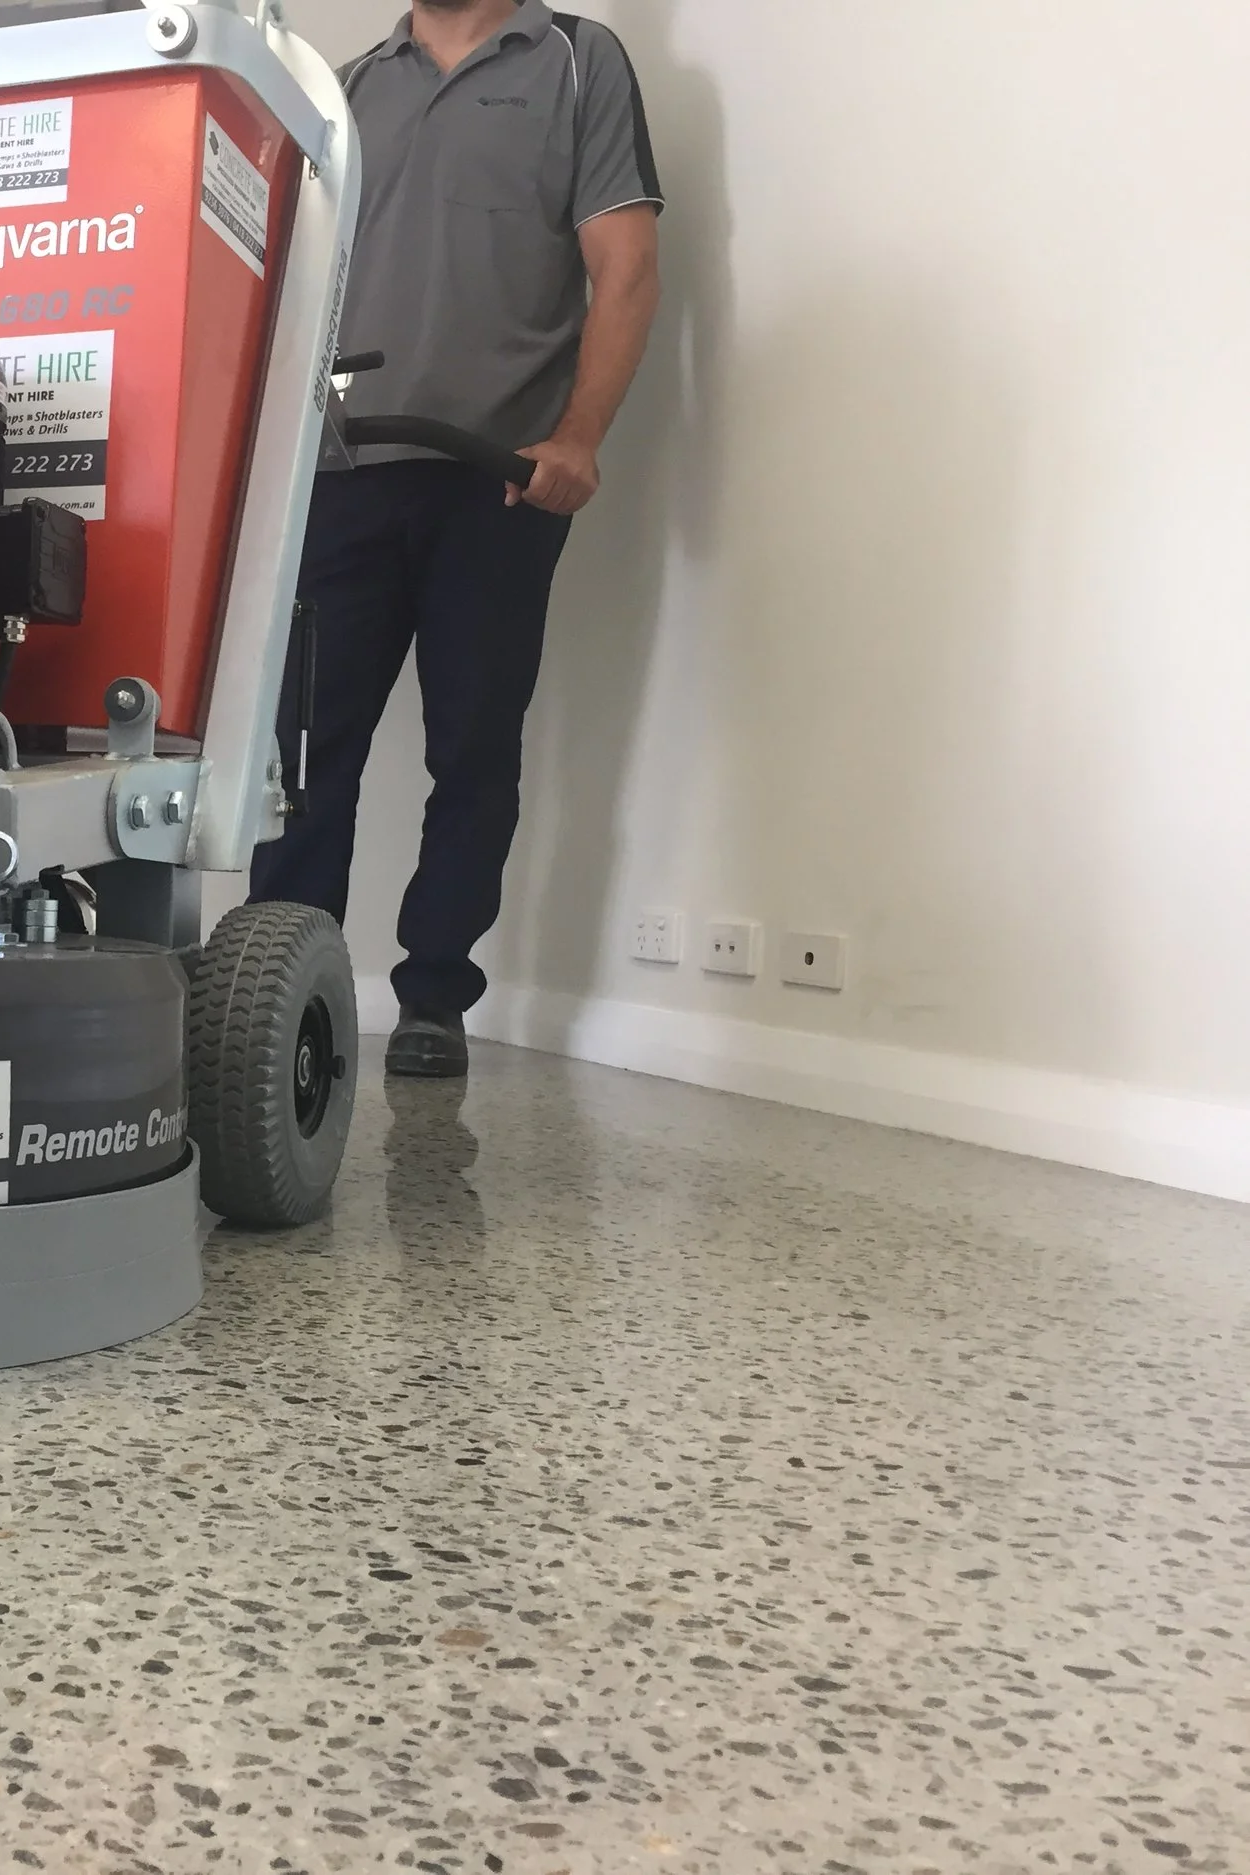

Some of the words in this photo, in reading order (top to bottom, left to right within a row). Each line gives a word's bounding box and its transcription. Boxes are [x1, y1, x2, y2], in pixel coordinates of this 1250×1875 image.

[23, 111, 62, 135] HIRE
[17, 138, 35, 147] HIRE
[21, 149, 65, 159] Shotblasters
[24, 159, 43, 168] Drills
[7, 174, 31, 187] 222
[34, 171, 60, 185] 273
[81, 285, 135, 319] RC
[319, 248, 348, 384] Husqvarna
[37, 350, 99, 385] HIRE
[27, 391, 55, 401] HIRE
[34, 410, 103, 422] Shotblasters
[3, 428, 23, 436] aws
[27, 425, 35, 435] &
[38, 424, 68, 435] Drills
[11, 456, 50, 474] 222
[55, 453, 94, 473] 273
[16, 1120, 140, 1166] Remote
